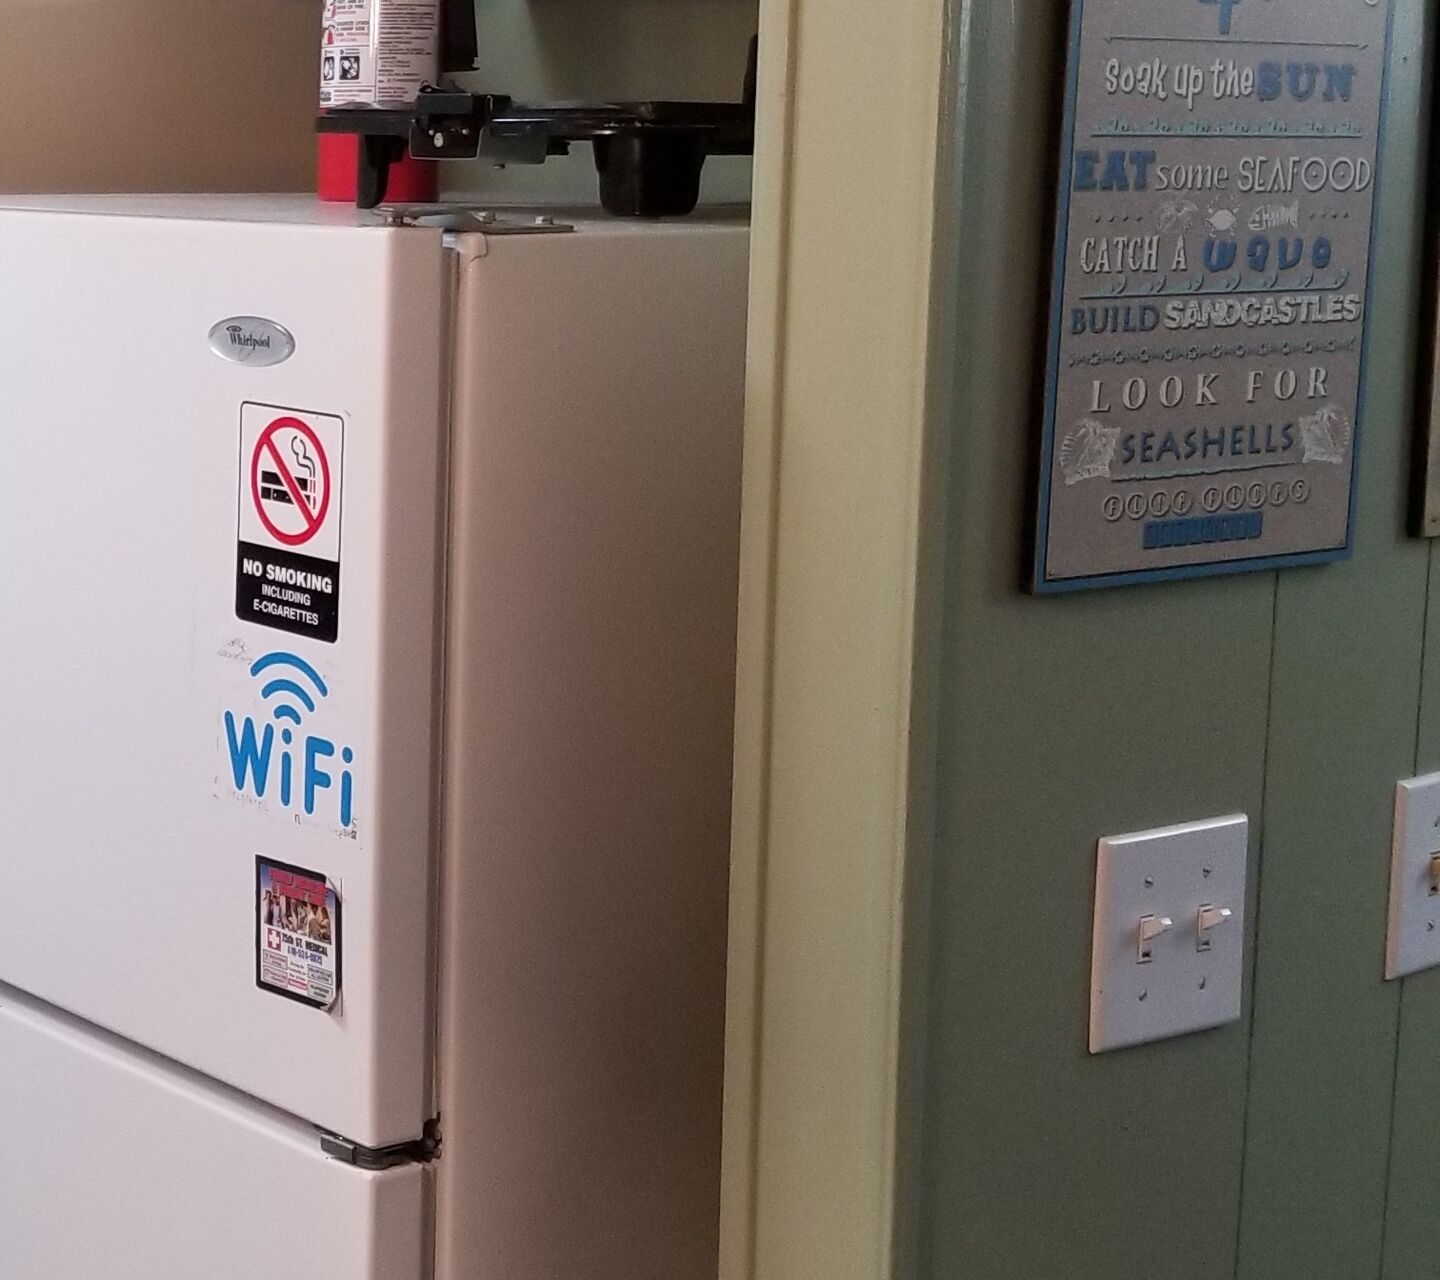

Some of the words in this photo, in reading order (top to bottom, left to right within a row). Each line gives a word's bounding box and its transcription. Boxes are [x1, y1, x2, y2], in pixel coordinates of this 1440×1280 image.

[1173, 61, 1204, 109] up
[1209, 58, 1255, 100] the
[1257, 60, 1358, 103] SUN
[1072, 149, 1157, 192] EAT
[1155, 160, 1230, 193] some
[1237, 155, 1371, 194] SEAFOOD
[1079, 234, 1160, 274] CATCH
[1171, 235, 1189, 271] A
[1071, 303, 1160, 335] BUILD
[1163, 293, 1361, 331] SANDCASTLES
[229, 331, 270, 351] Whirlpool
[1089, 372, 1219, 414] LOOK
[1246, 366, 1330, 403] FOR
[1121, 423, 1296, 466] SEASHELLS
[242, 557, 263, 577] NO
[265, 563, 333, 594] SMOKING
[261, 583, 311, 606] INCLUDING
[252, 598, 319, 626] E-CIGARETTES
[224, 710, 354, 828] WiFi
